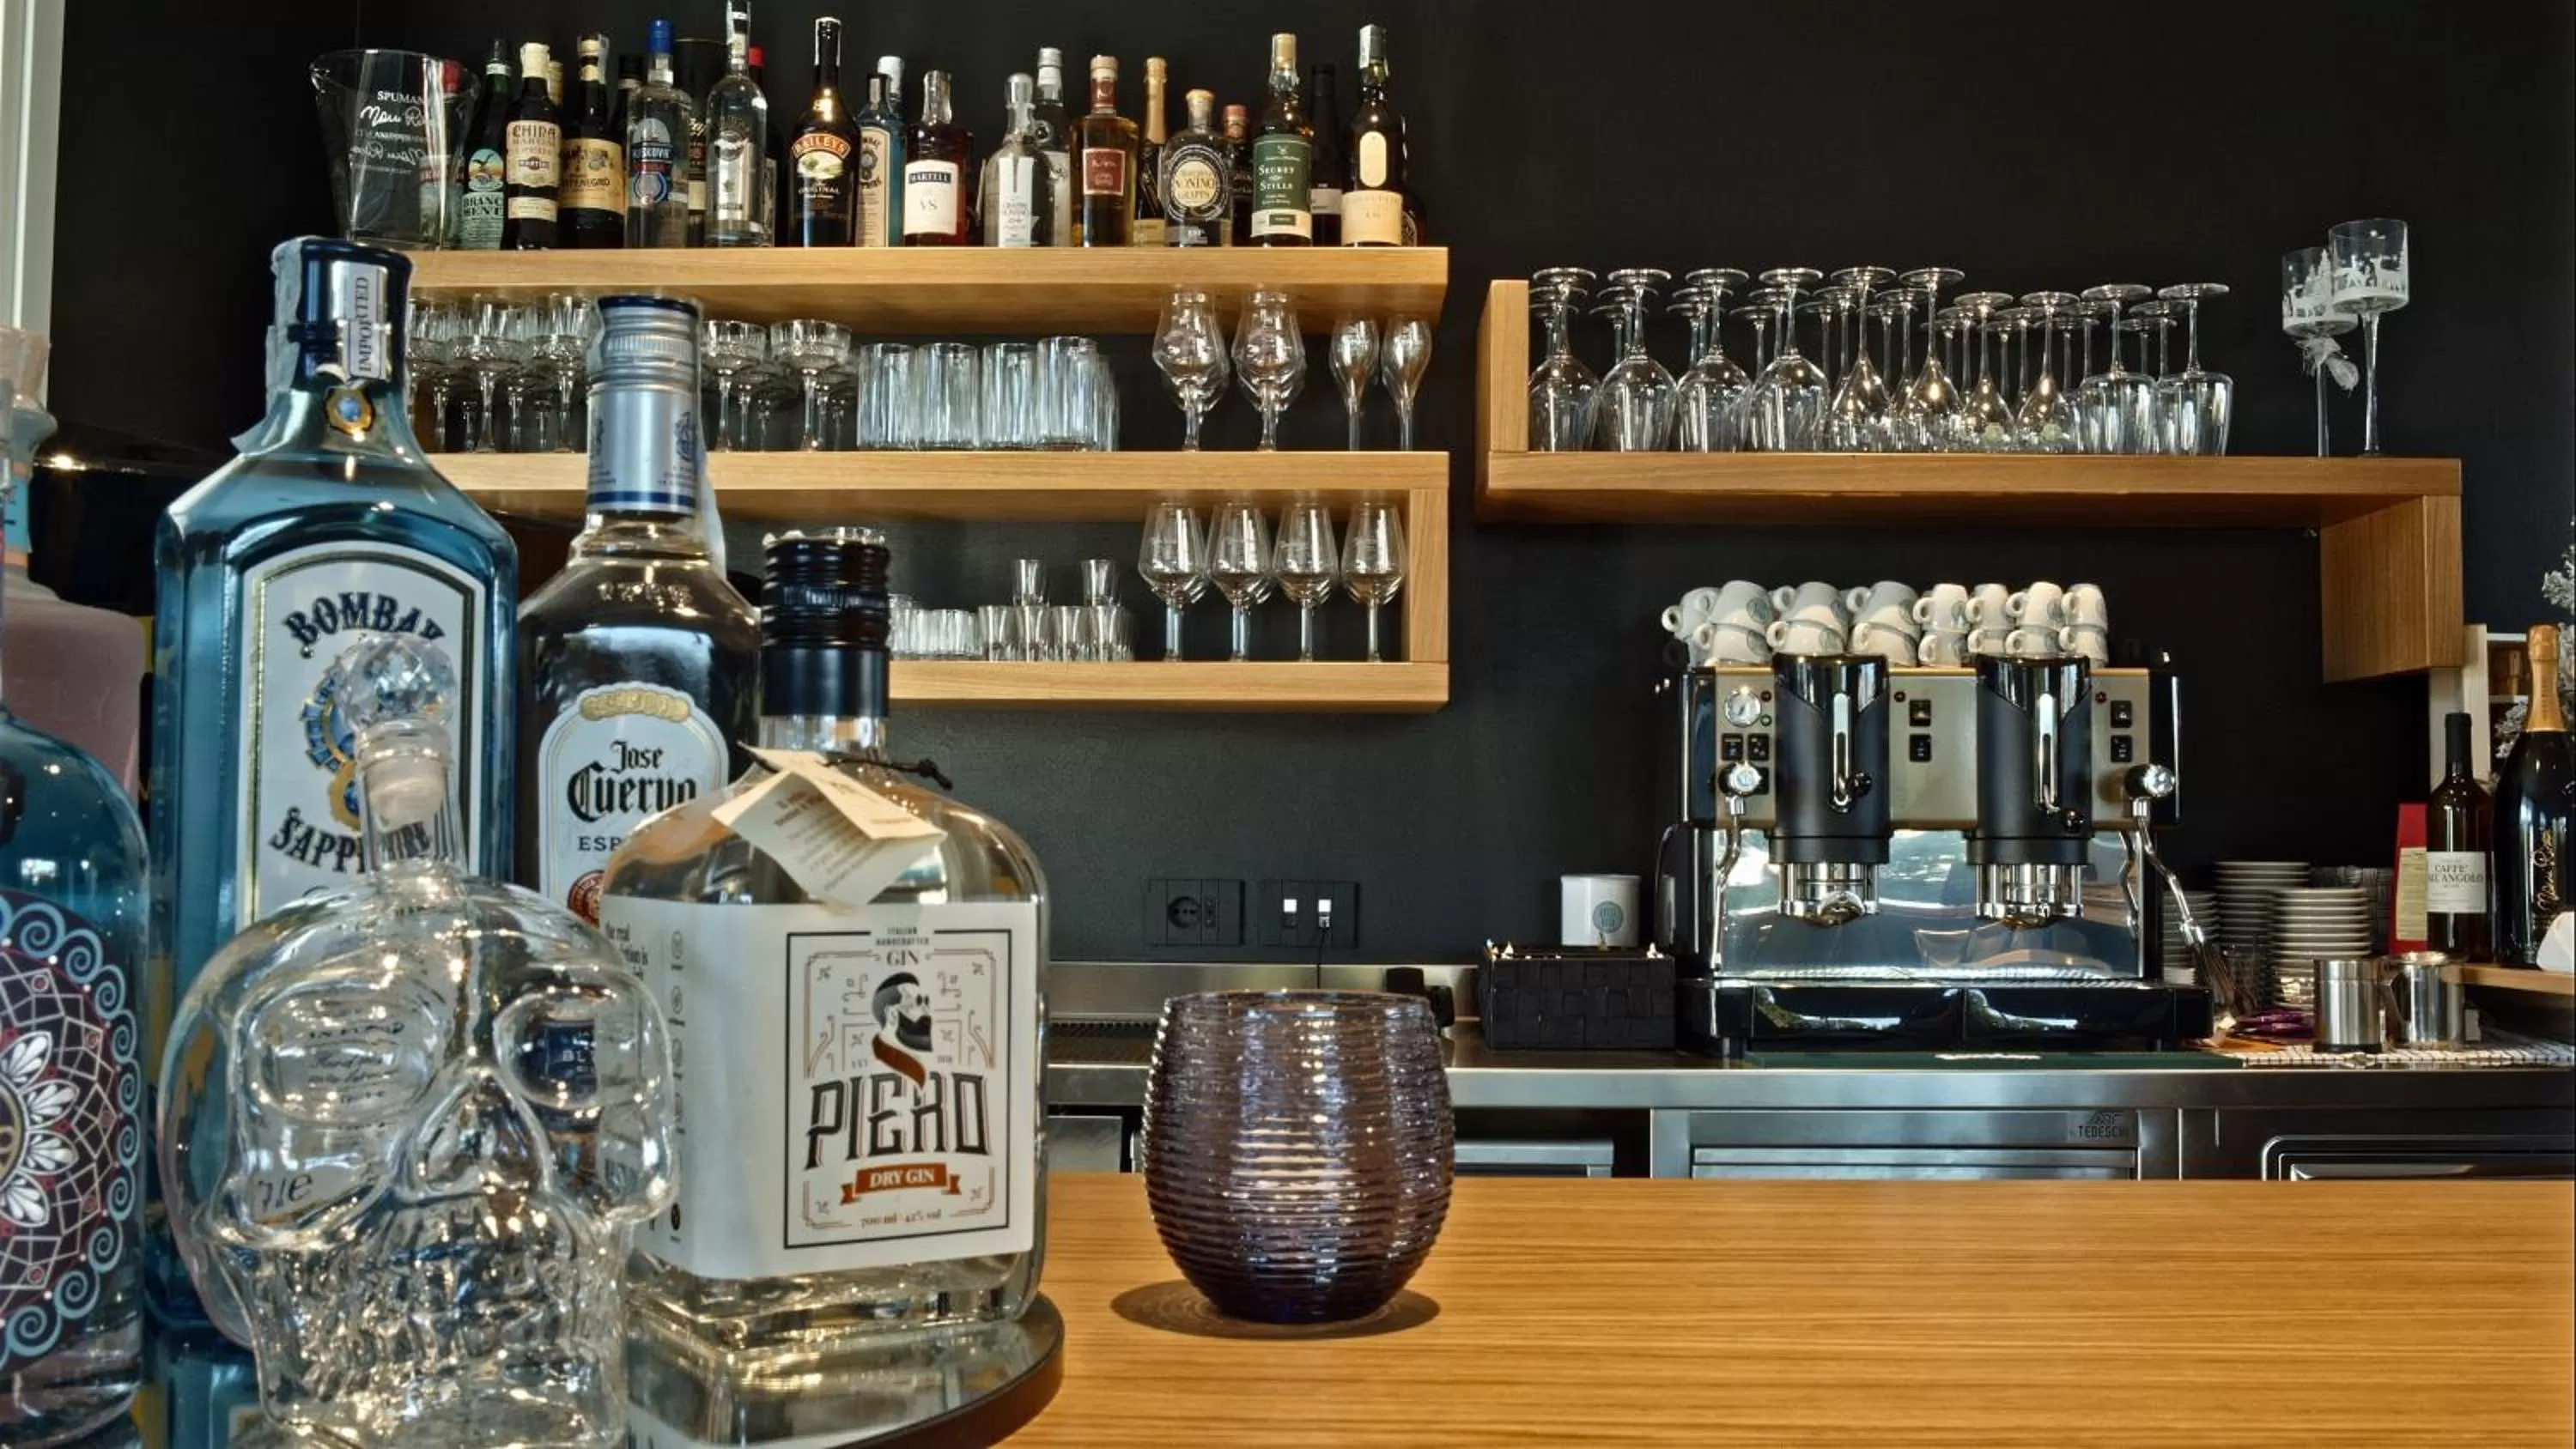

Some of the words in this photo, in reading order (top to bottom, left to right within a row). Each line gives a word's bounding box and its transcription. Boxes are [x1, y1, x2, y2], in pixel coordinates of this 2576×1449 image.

[794, 134, 846, 155] BAILEYS
[911, 173, 950, 182] MARTELL
[1258, 164, 1295, 176] SECRET
[355, 276, 373, 374] IMPORTED
[282, 591, 447, 651] BOMBAY
[611, 740, 664, 774] Jose
[567, 761, 697, 823] Cuervo
[887, 926, 918, 935] ITALIAN
[875, 937, 930, 946] HANDCRAFTED
[886, 949, 920, 966] GIN
[804, 1072, 990, 1170] PIERO
[869, 1173, 902, 1189] DRY
[906, 1168, 936, 1185] GIN
